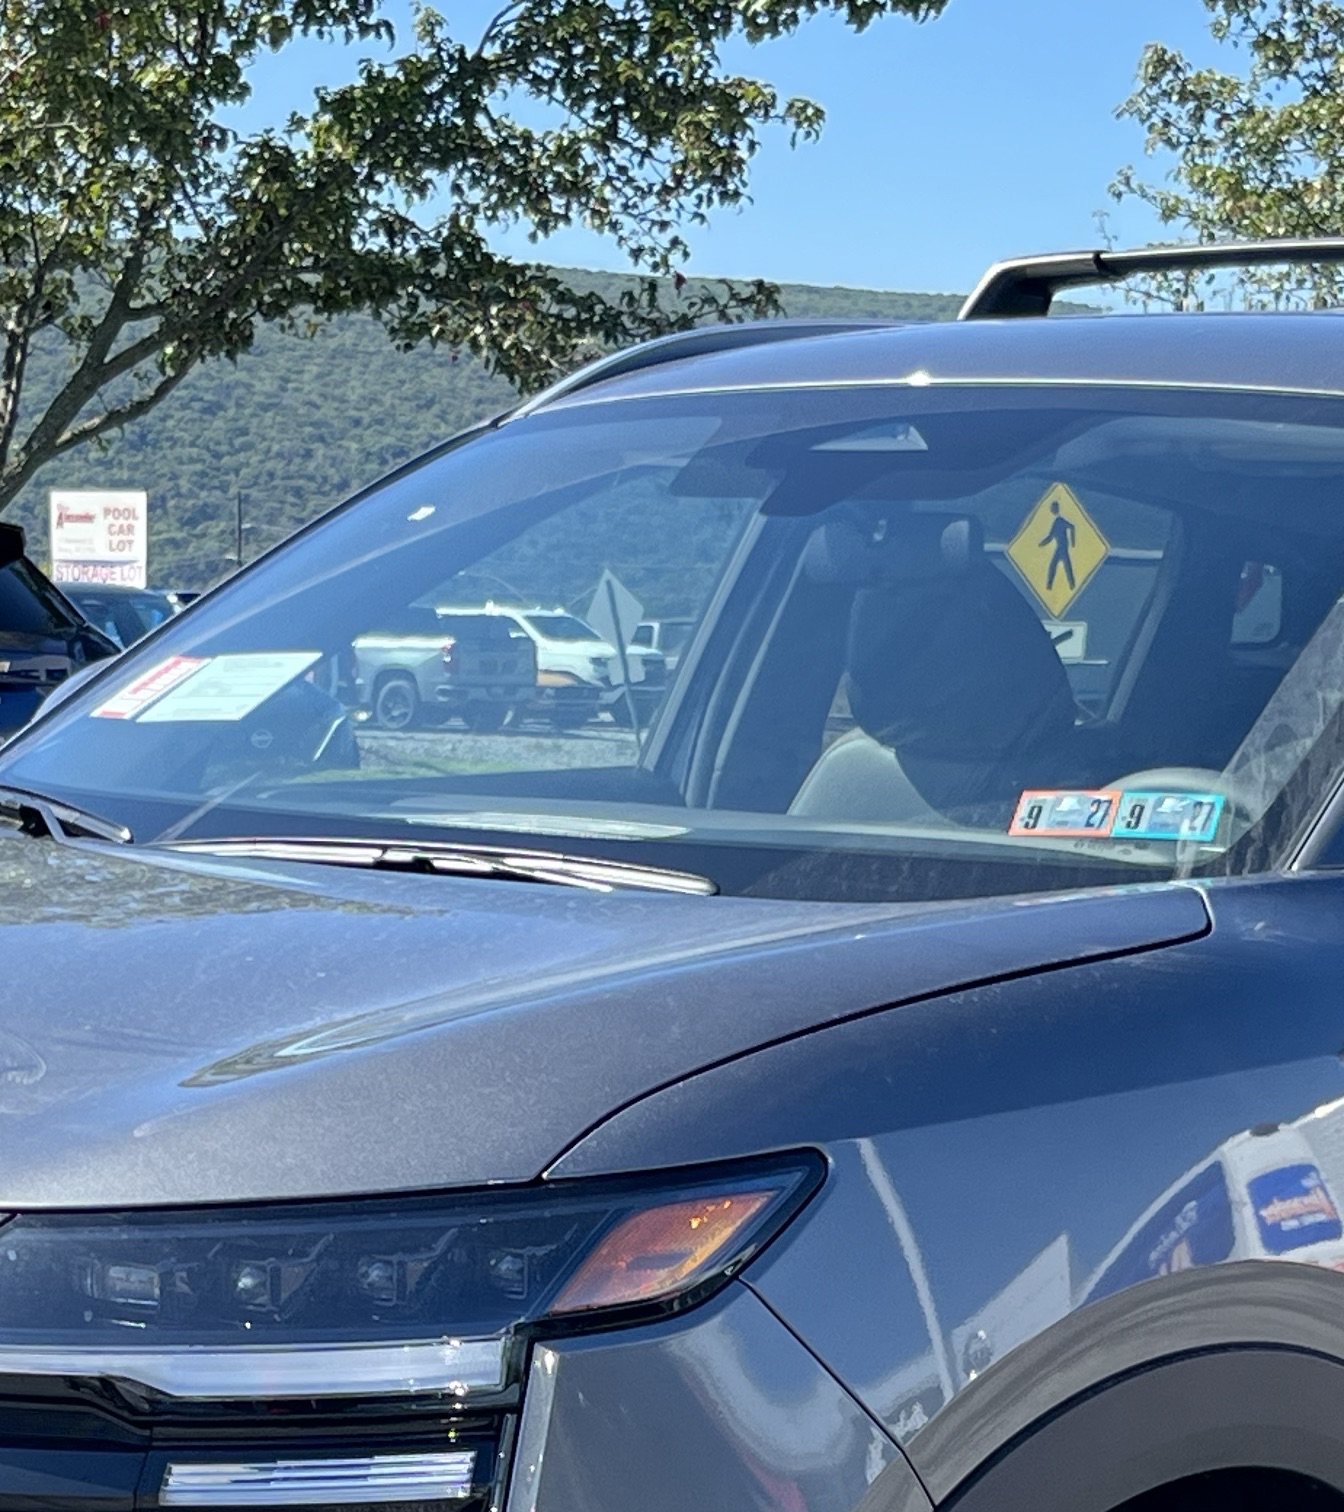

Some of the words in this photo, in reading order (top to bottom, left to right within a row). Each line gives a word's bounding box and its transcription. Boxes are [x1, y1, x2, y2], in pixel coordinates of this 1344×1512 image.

[103, 507, 139, 521] POOL
[108, 523, 135, 536] CAR
[109, 539, 134, 553] LOT
[56, 564, 117, 583] STORAGE
[120, 565, 143, 581] LOT
[1023, 805, 1043, 830] 9
[1084, 799, 1112, 829] 27
[1125, 804, 1145, 830] 9
[1188, 801, 1216, 833] 27
